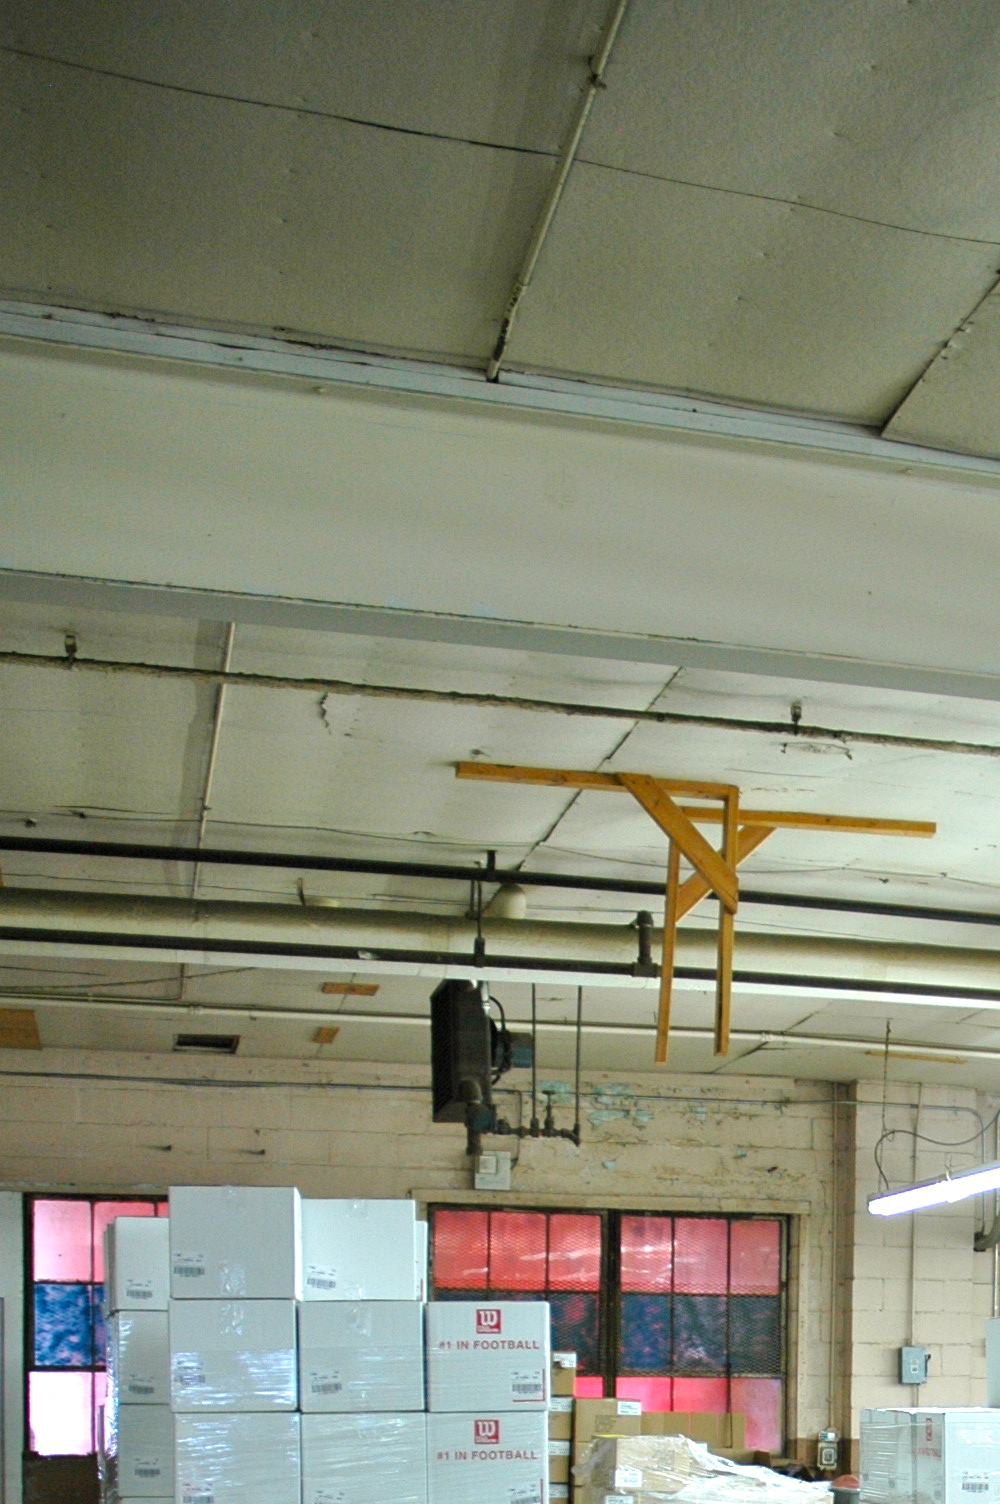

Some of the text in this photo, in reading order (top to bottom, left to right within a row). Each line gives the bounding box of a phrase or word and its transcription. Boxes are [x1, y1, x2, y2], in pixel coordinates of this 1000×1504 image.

[456, 1341, 469, 1350] IN
[473, 1339, 540, 1350] FOOTBALL
[454, 1451, 467, 1460] IN
[471, 1450, 538, 1460] FOOTBALL
